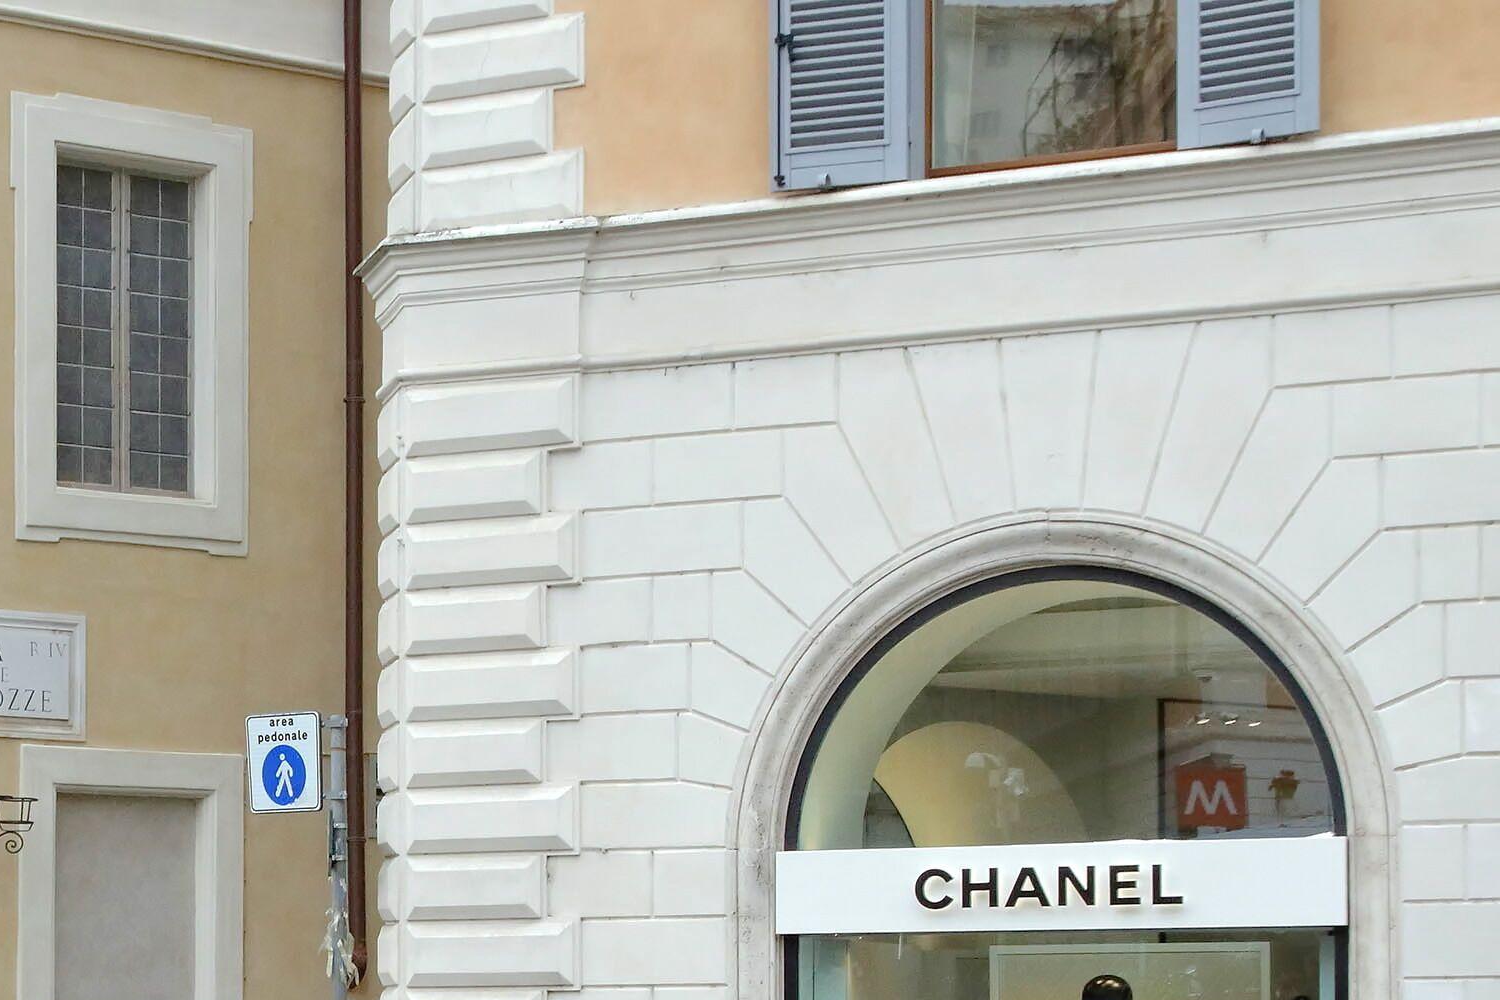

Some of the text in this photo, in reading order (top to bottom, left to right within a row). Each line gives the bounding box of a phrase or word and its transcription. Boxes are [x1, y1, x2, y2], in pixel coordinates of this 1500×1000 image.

[269, 718, 294, 727] area
[258, 730, 308, 744] pedonale
[914, 863, 1184, 910] CHANEL
